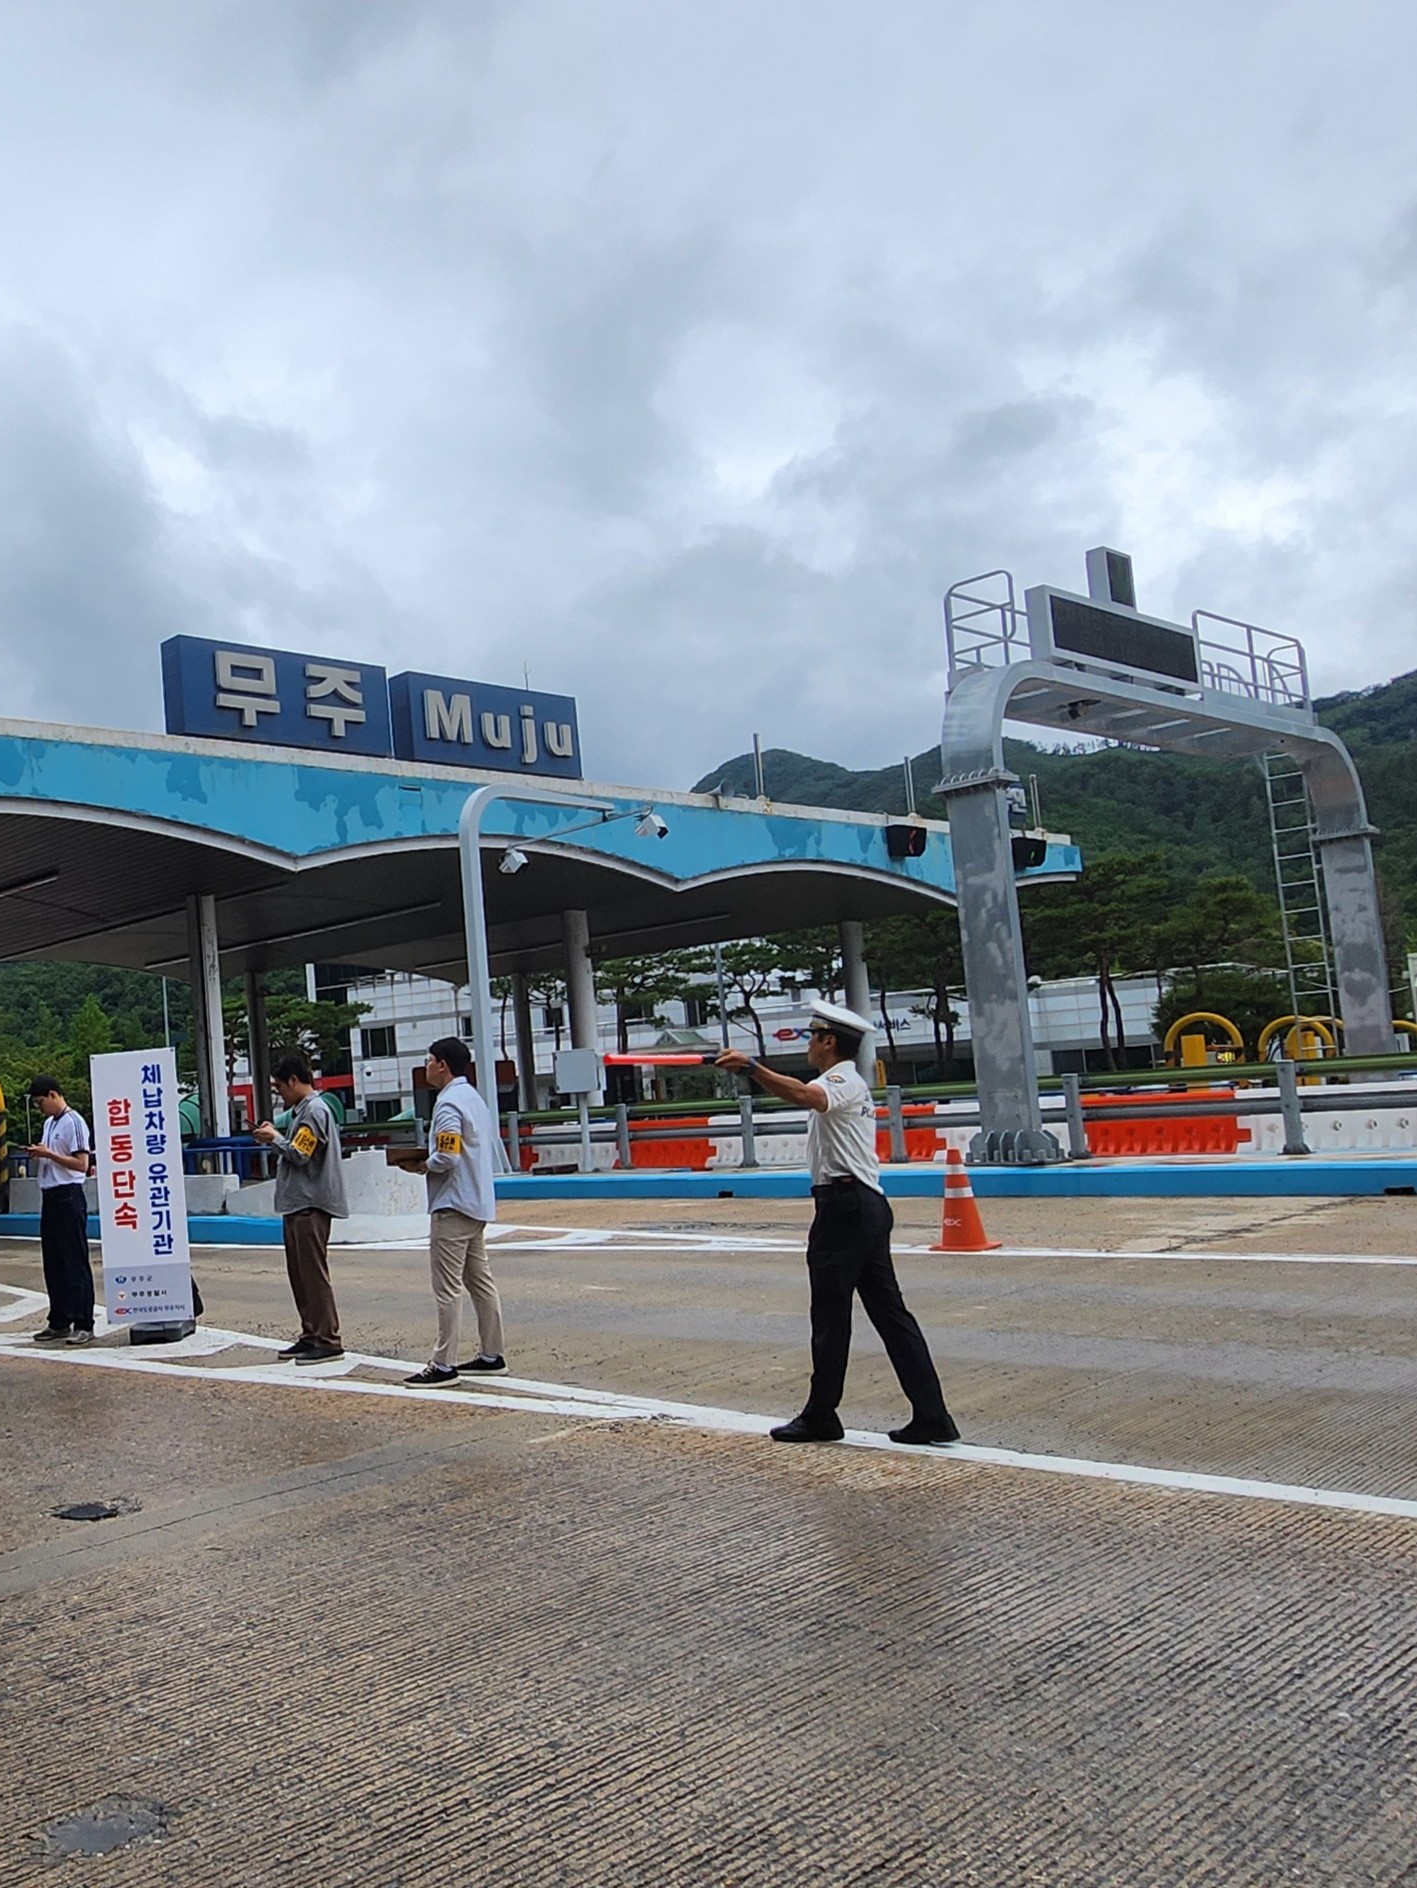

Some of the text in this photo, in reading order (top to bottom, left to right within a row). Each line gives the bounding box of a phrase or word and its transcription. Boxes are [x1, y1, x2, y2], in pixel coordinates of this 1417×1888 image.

[215, 650, 367, 737] 무주
[424, 689, 573, 765] Muju
[141, 1064, 174, 1255] 체납차량 유관기관
